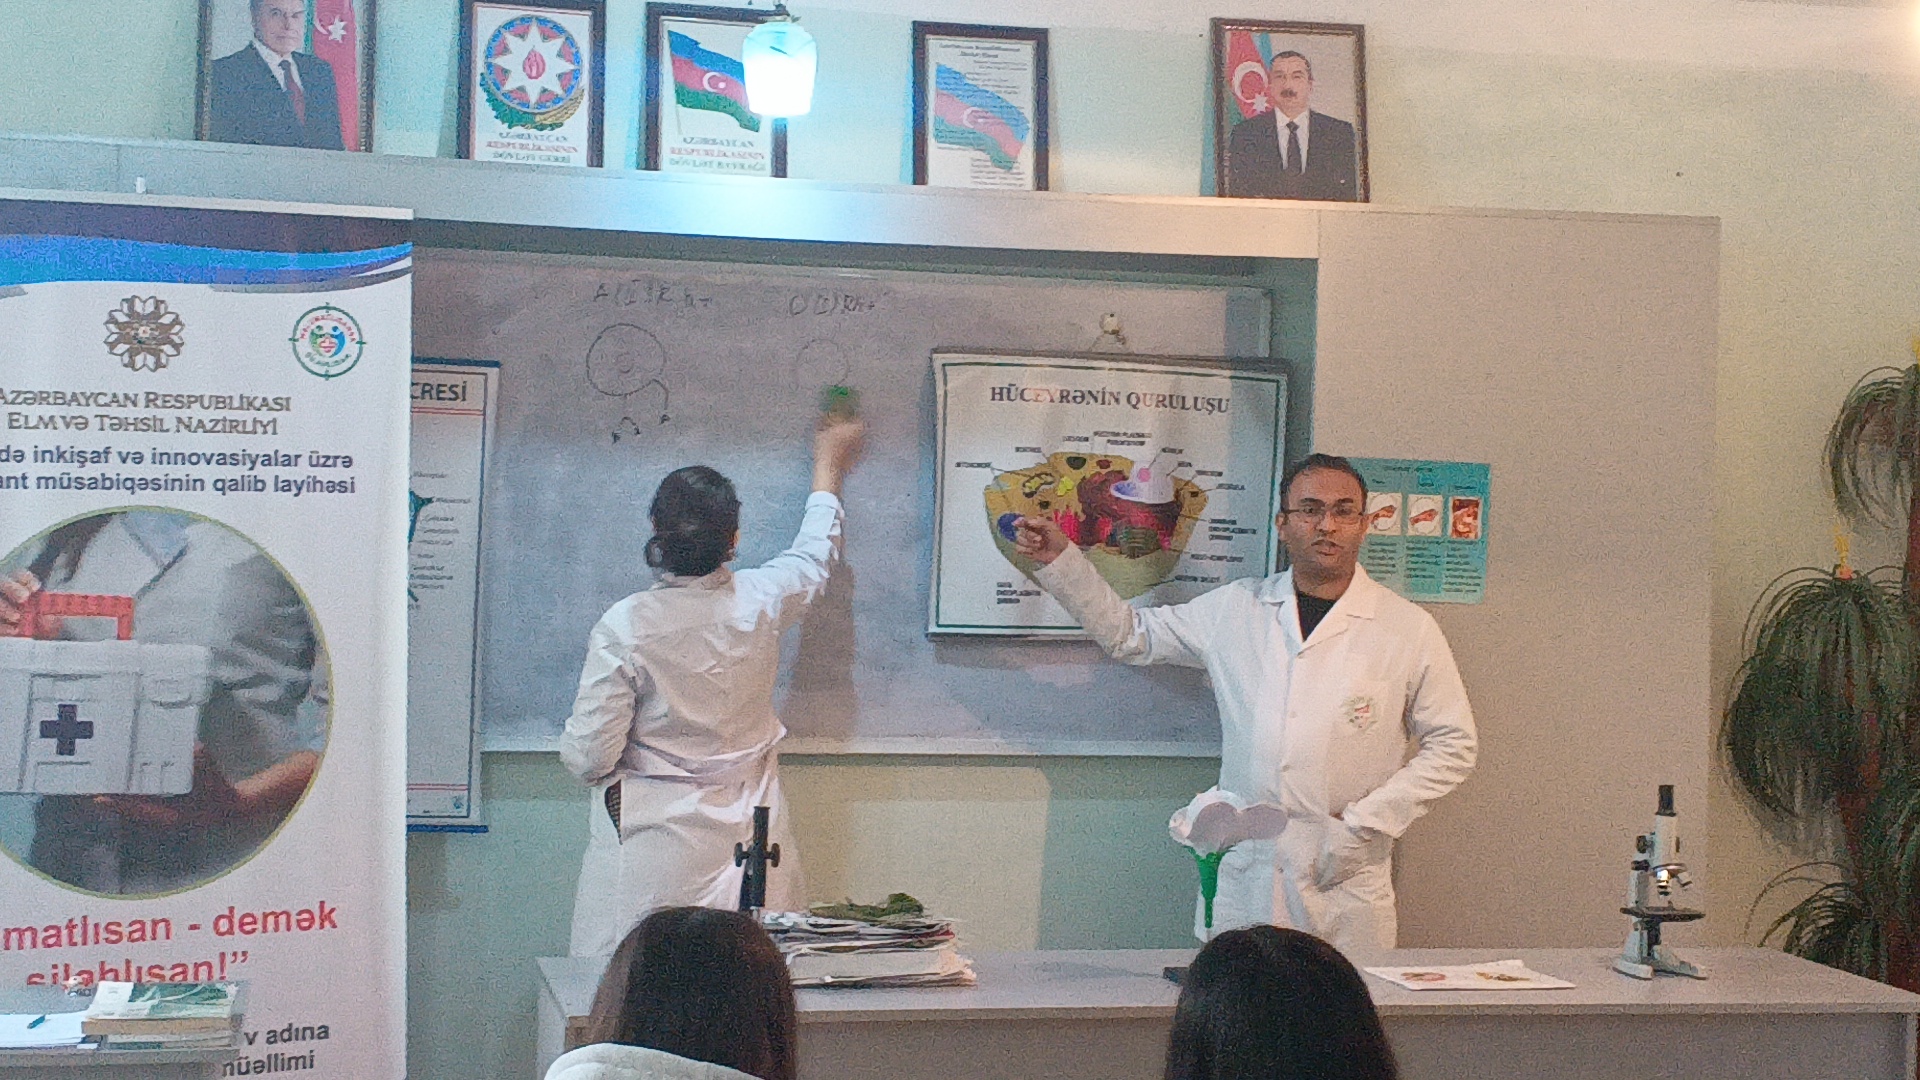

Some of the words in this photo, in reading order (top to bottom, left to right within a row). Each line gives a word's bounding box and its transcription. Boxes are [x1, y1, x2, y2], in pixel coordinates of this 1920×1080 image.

[144, 391, 292, 412] RESPUBLİKASI
[989, 383, 1121, 405] HÜCEYRƏNİN
[1126, 391, 1230, 415] QURULUŞU
[8, 411, 58, 430] ELM
[60, 414, 89, 431] VƏ
[94, 414, 170, 433] TƏHSİL
[175, 416, 278, 435] NAZİRLİYİ
[33, 445, 112, 468] inkişaf
[119, 450, 144, 466] və
[151, 449, 301, 474] innovasiyalar
[308, 450, 354, 469] üzrə
[36, 472, 205, 495] müsabiqəsinin
[213, 475, 267, 498] qalib
[273, 476, 356, 497] layihəsi
[3, 915, 172, 950] matlısan
[213, 901, 338, 937] demək
[266, 1022, 330, 1045] adına
